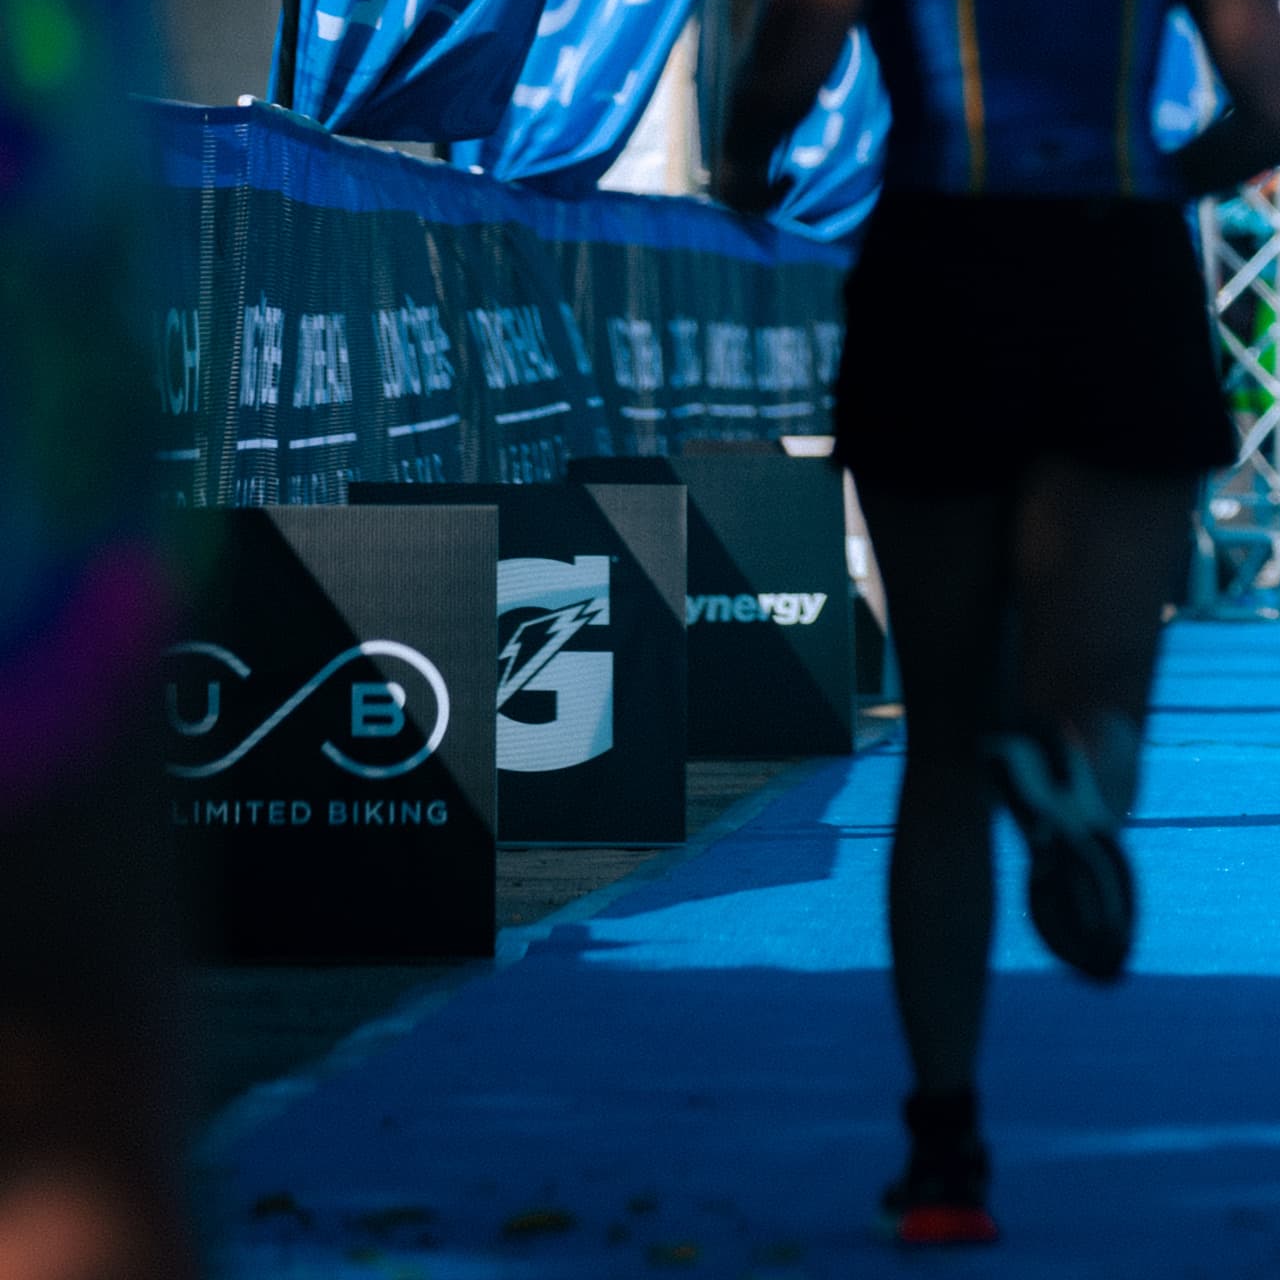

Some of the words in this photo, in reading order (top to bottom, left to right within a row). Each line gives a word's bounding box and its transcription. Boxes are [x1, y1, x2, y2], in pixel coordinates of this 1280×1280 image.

[686, 592, 828, 626] ynergy
[351, 681, 406, 737] B
[327, 799, 448, 826] BIKING
